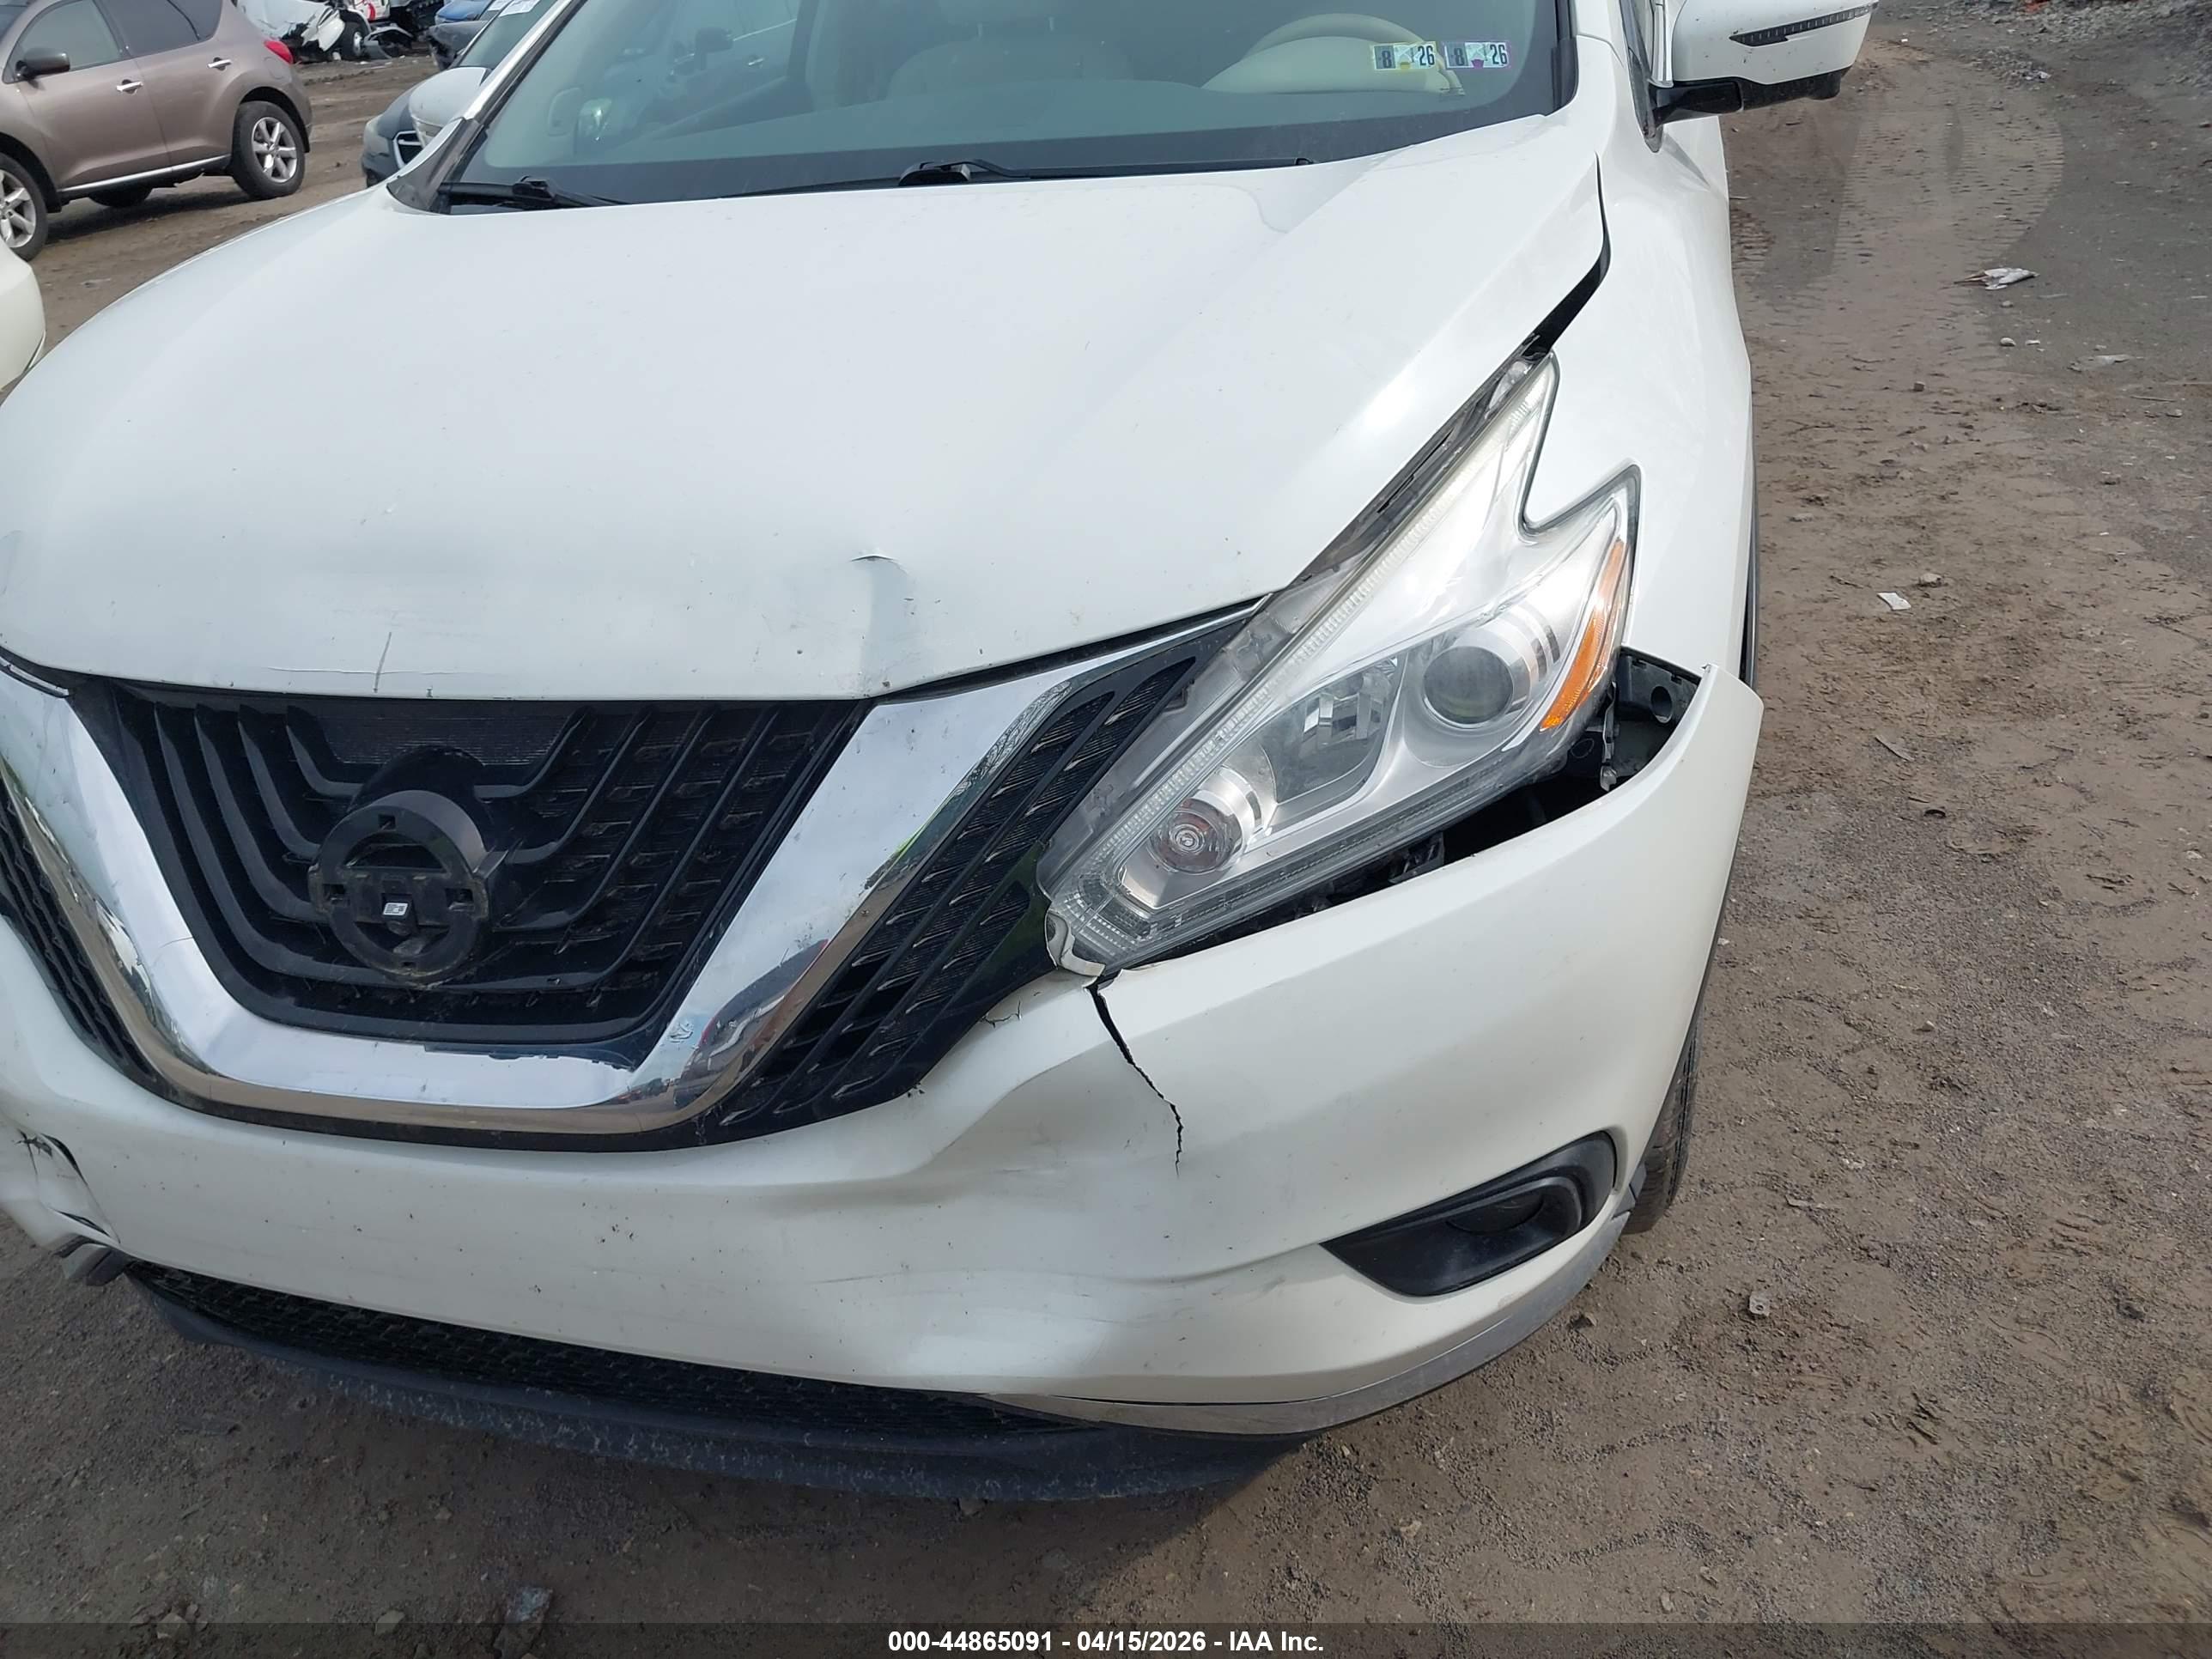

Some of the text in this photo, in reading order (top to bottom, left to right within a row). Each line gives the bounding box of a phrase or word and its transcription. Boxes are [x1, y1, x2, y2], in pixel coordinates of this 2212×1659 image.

[1382, 46, 1435, 68] 8 26
[1454, 44, 1508, 66] 8 26
